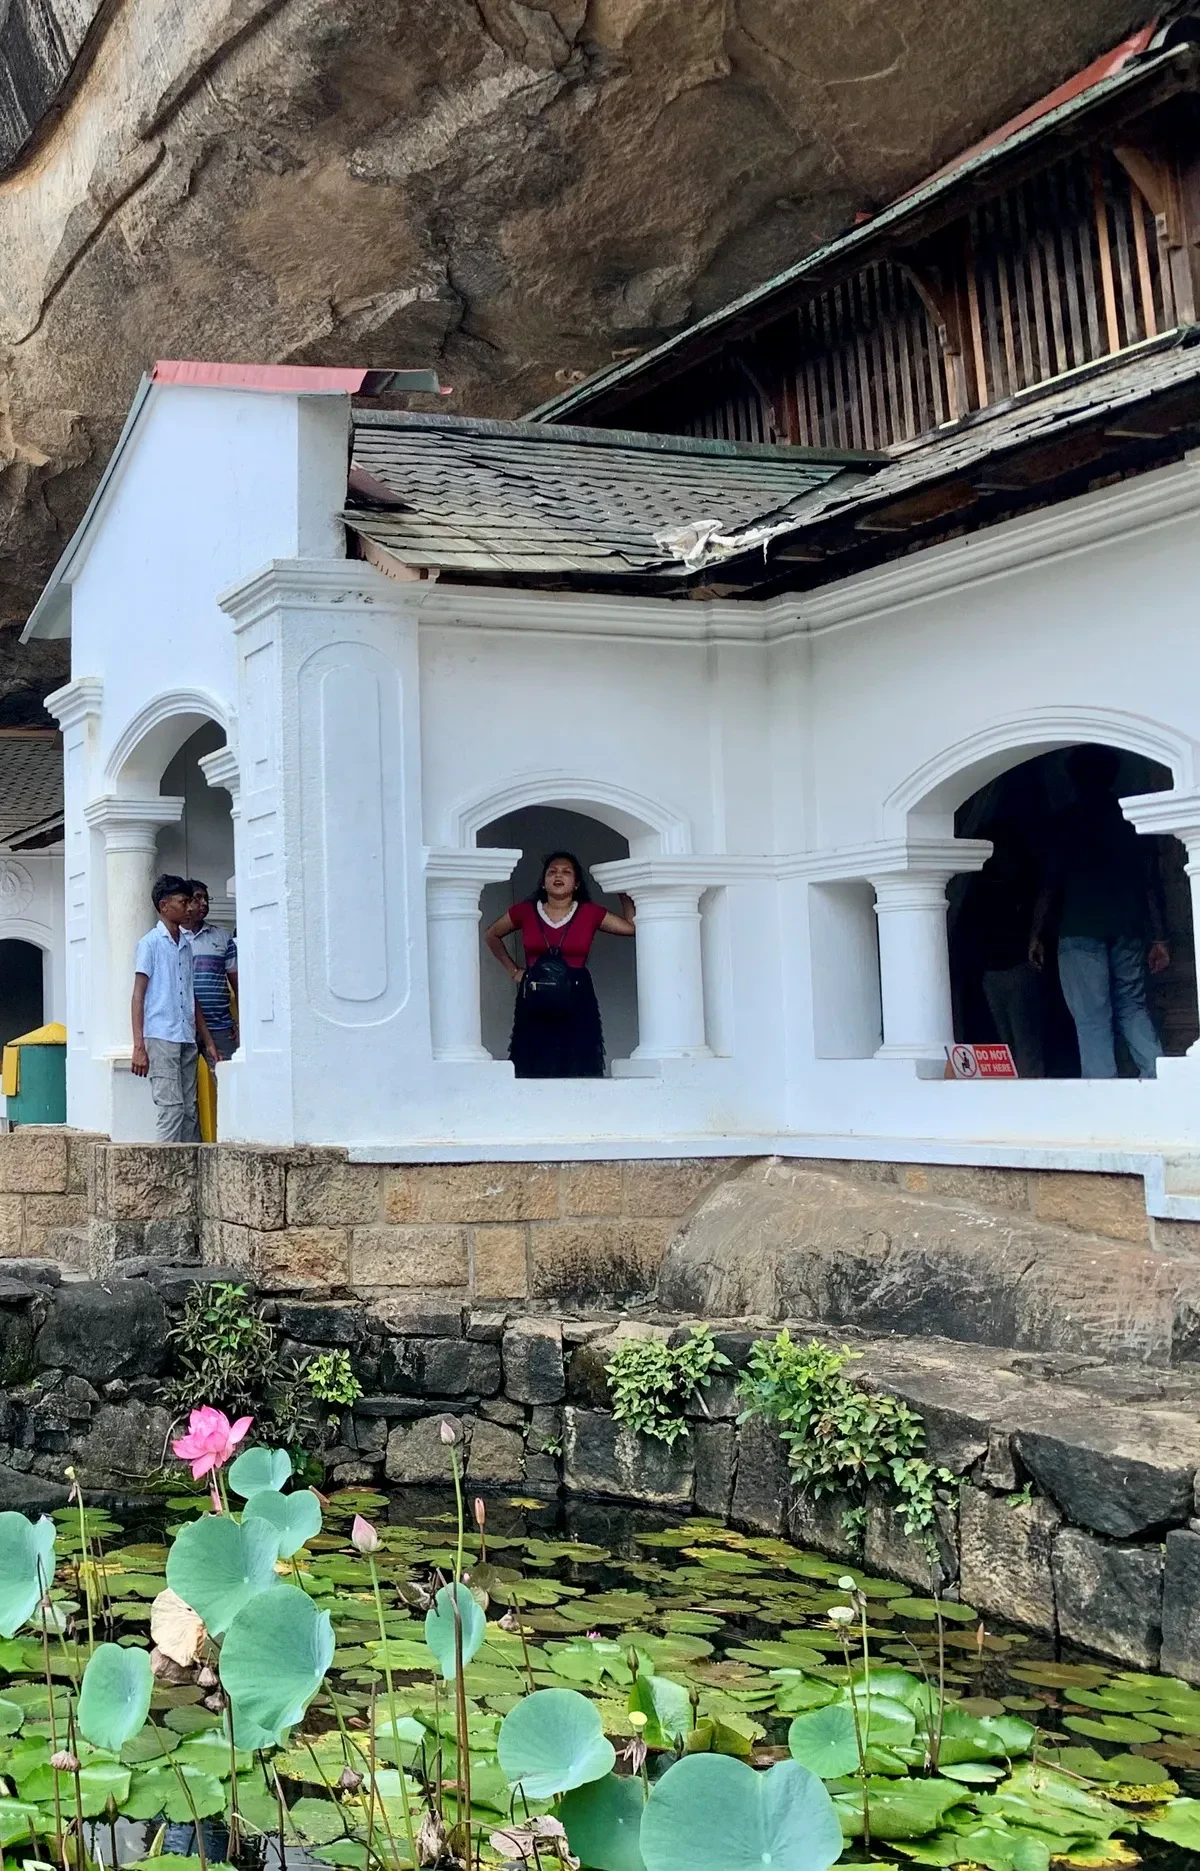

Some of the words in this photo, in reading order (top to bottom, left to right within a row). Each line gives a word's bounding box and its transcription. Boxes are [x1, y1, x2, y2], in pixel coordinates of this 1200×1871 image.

[976, 1050, 989, 1060] DO
[990, 1050, 1007, 1060] NOT
[980, 1063, 992, 1072] SIT
[992, 1063, 1012, 1072] HERE
